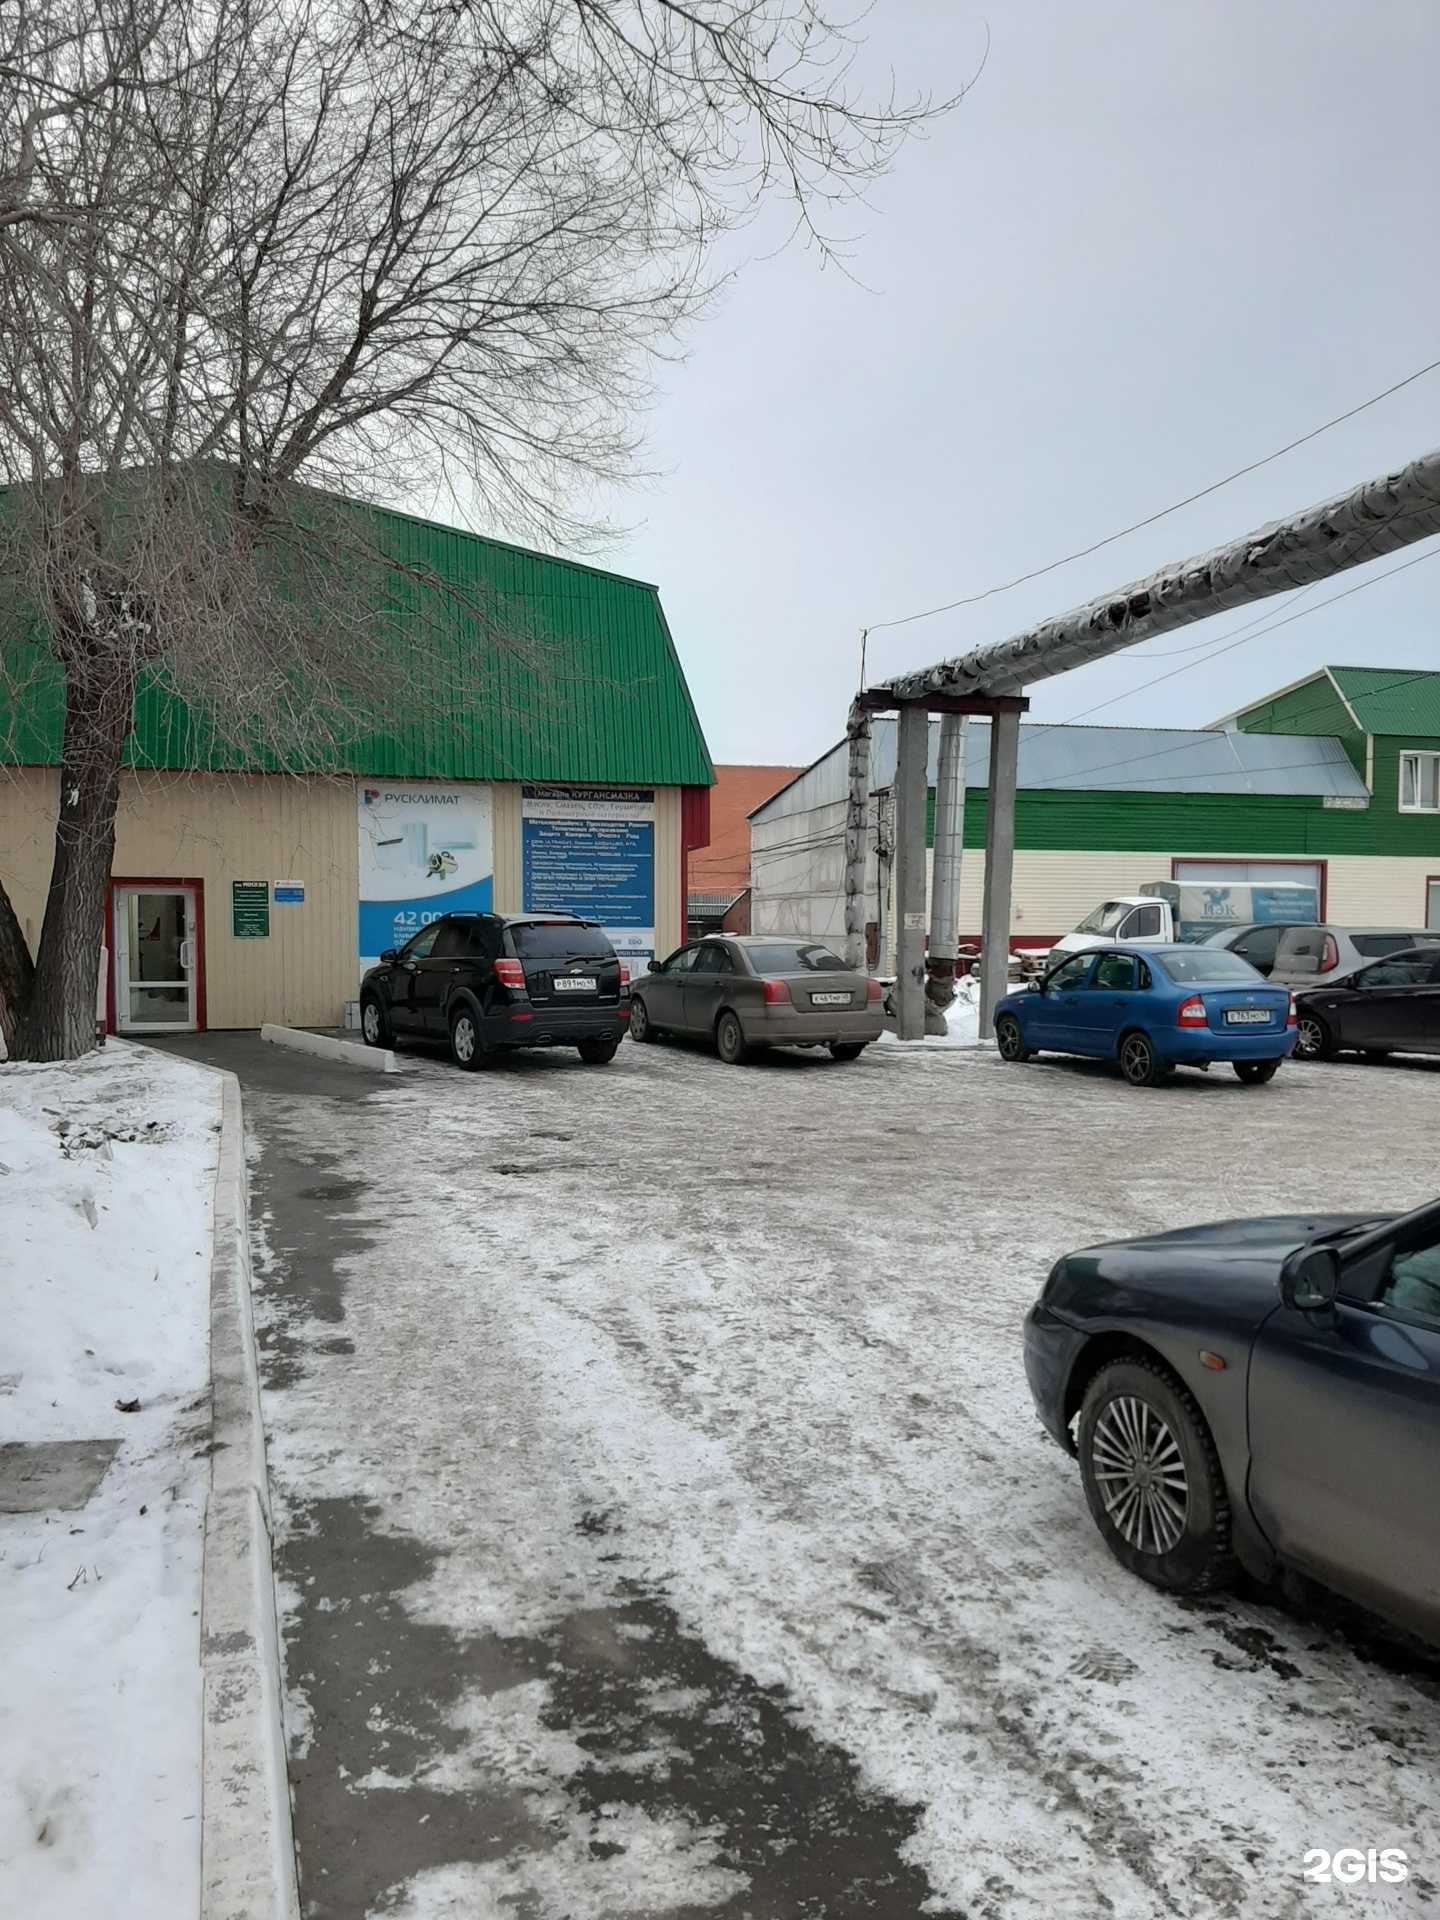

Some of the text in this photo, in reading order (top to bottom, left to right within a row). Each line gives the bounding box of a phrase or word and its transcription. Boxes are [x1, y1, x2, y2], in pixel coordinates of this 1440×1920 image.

[384, 793, 461, 805] РУСКЛИМАТ
[571, 790, 640, 800] КУРГАНСМАЗКА
[393, 911, 417, 925] 42
